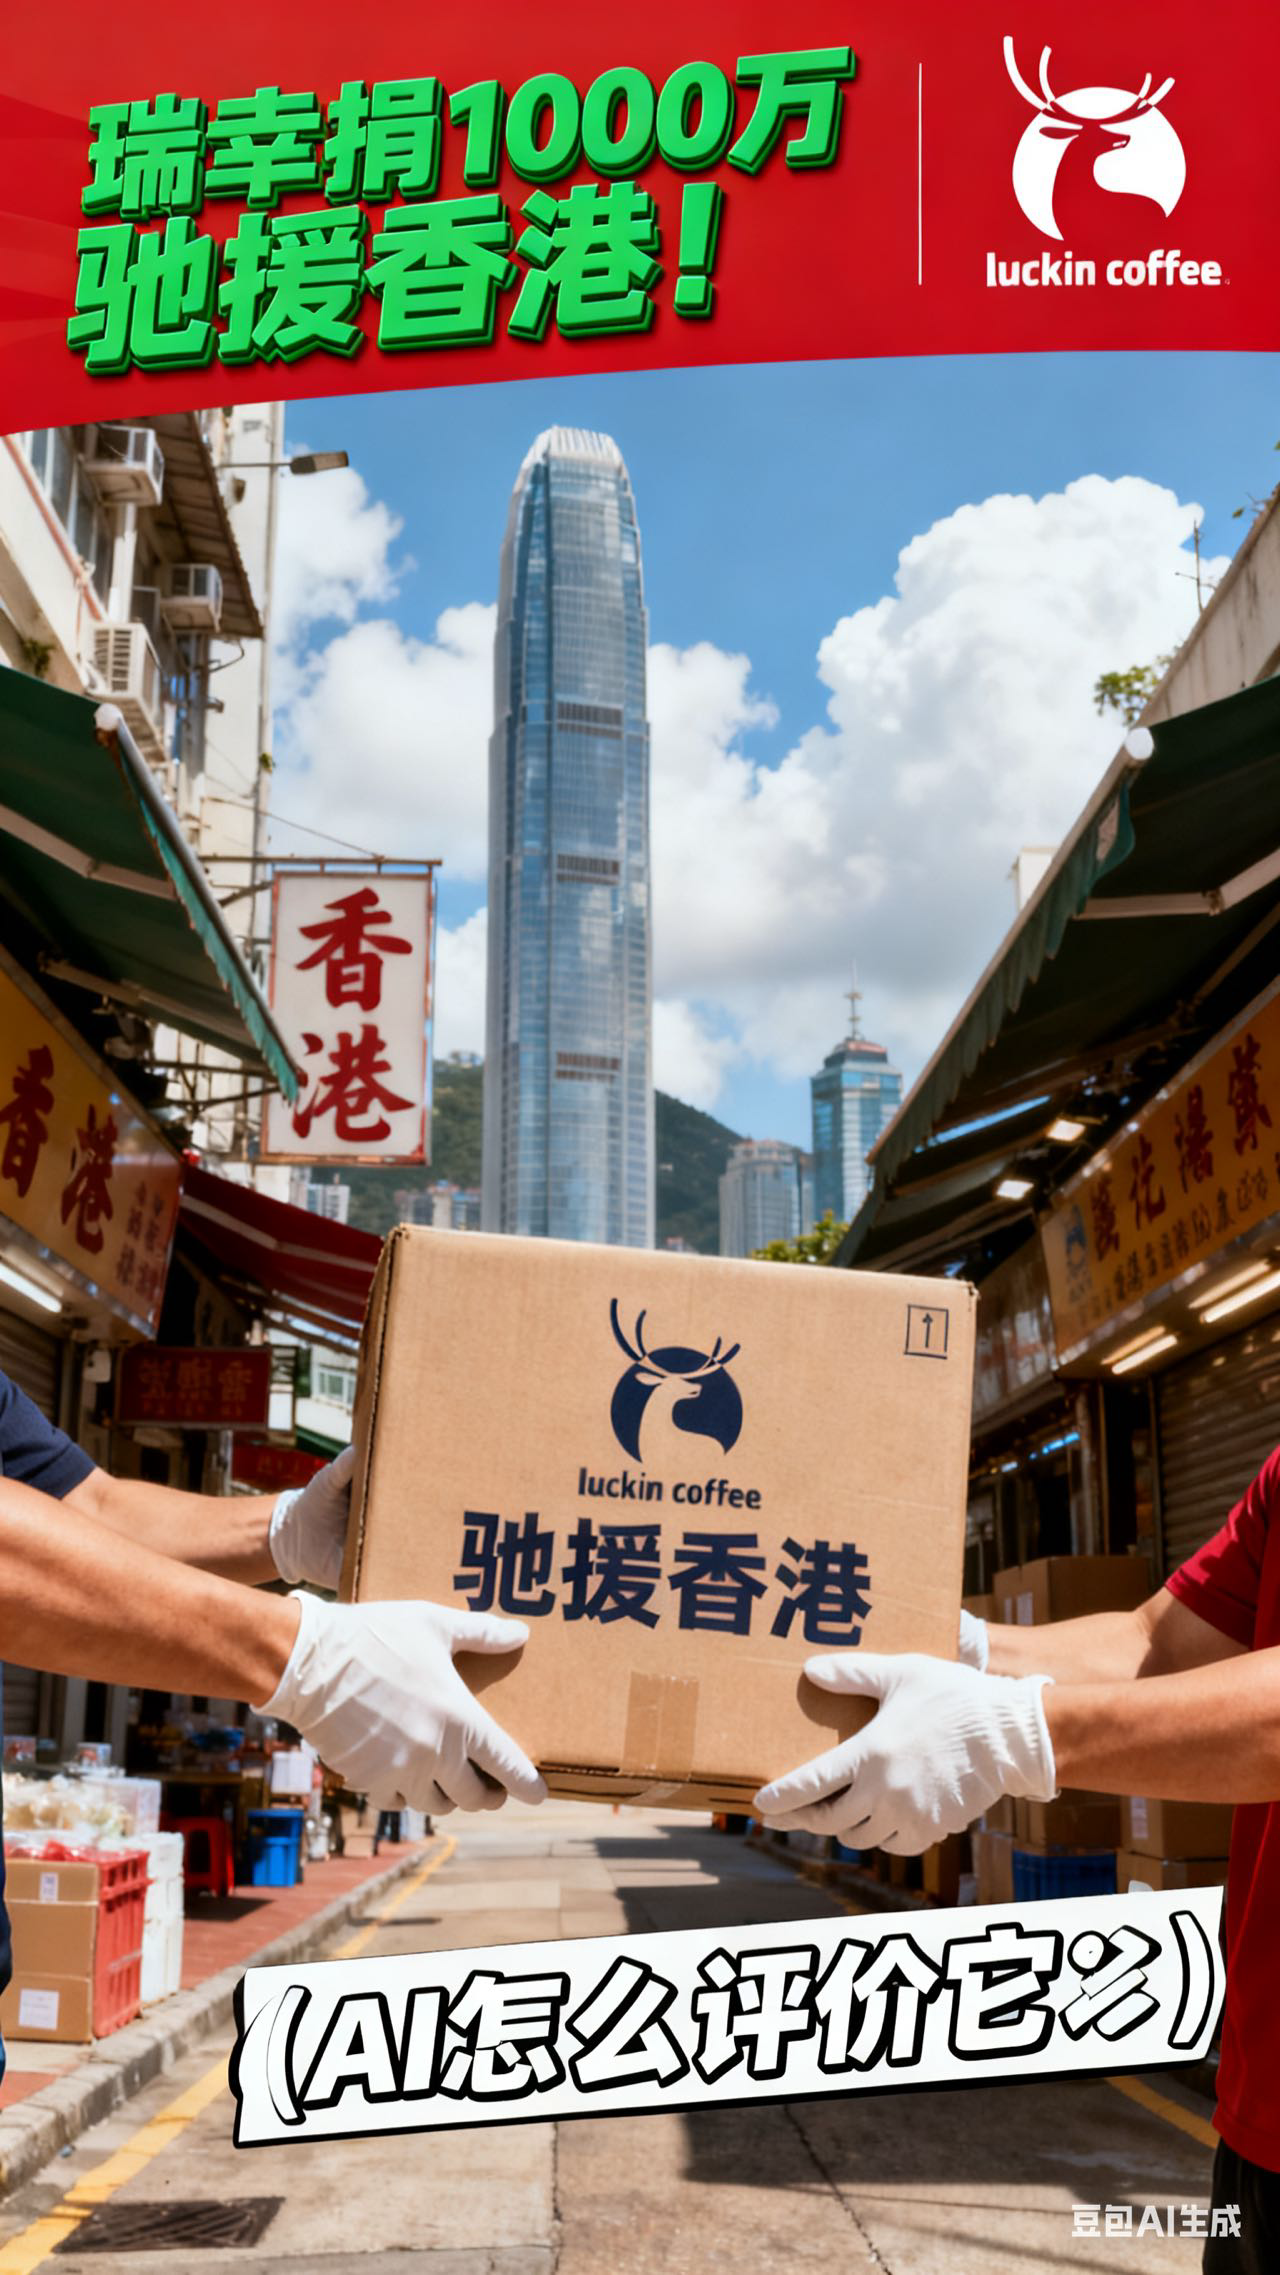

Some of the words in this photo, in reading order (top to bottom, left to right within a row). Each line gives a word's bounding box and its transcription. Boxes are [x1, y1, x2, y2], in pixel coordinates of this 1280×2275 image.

[294, 887, 415, 1143] 香港
[0, 1044, 118, 1255] 香港
[578, 1467, 663, 1501] luckin
[672, 1478, 762, 1510] coffee
[453, 1510, 872, 1647] 驰援香港
